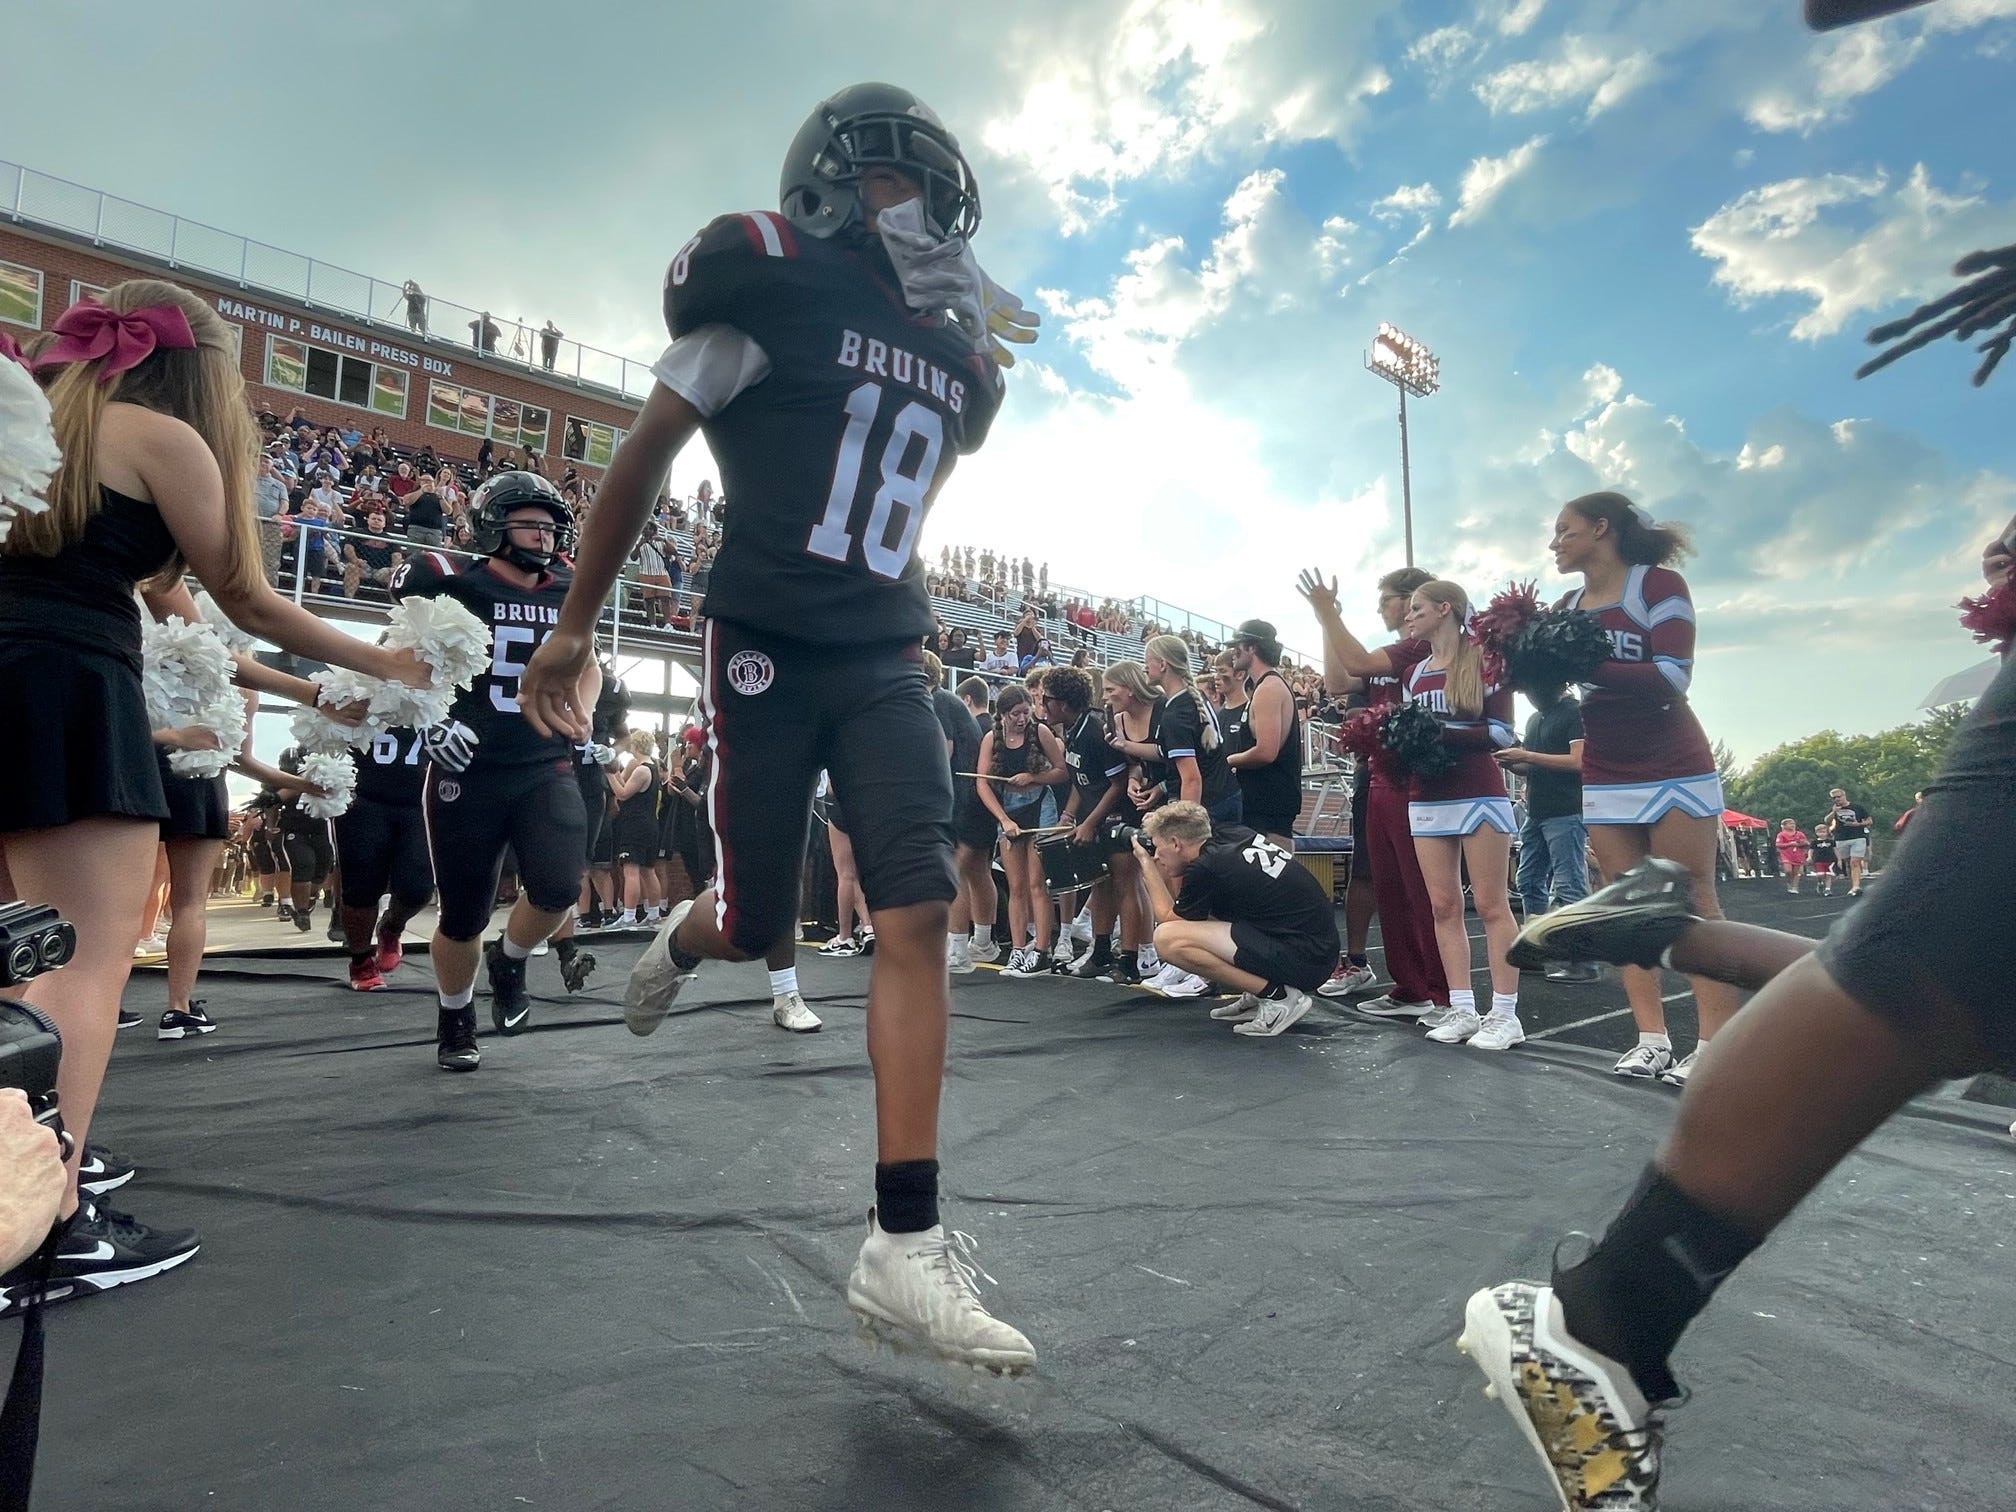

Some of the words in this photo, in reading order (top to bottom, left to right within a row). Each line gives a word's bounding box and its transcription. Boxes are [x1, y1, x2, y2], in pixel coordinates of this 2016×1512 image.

[664, 236, 702, 290] 8
[218, 298, 284, 329] MARTIN
[290, 319, 305, 336] P.
[310, 326, 366, 353] BAILEN
[370, 341, 419, 367] PRESS
[423, 357, 453, 377] BOX
[838, 329, 966, 414] BRUINS
[806, 381, 944, 580] 18
[390, 563, 411, 589] 3
[493, 602, 558, 625] BRUIN
[1604, 629, 1643, 661] NS
[742, 662, 758, 683] B
[1242, 833, 1293, 879] 25
